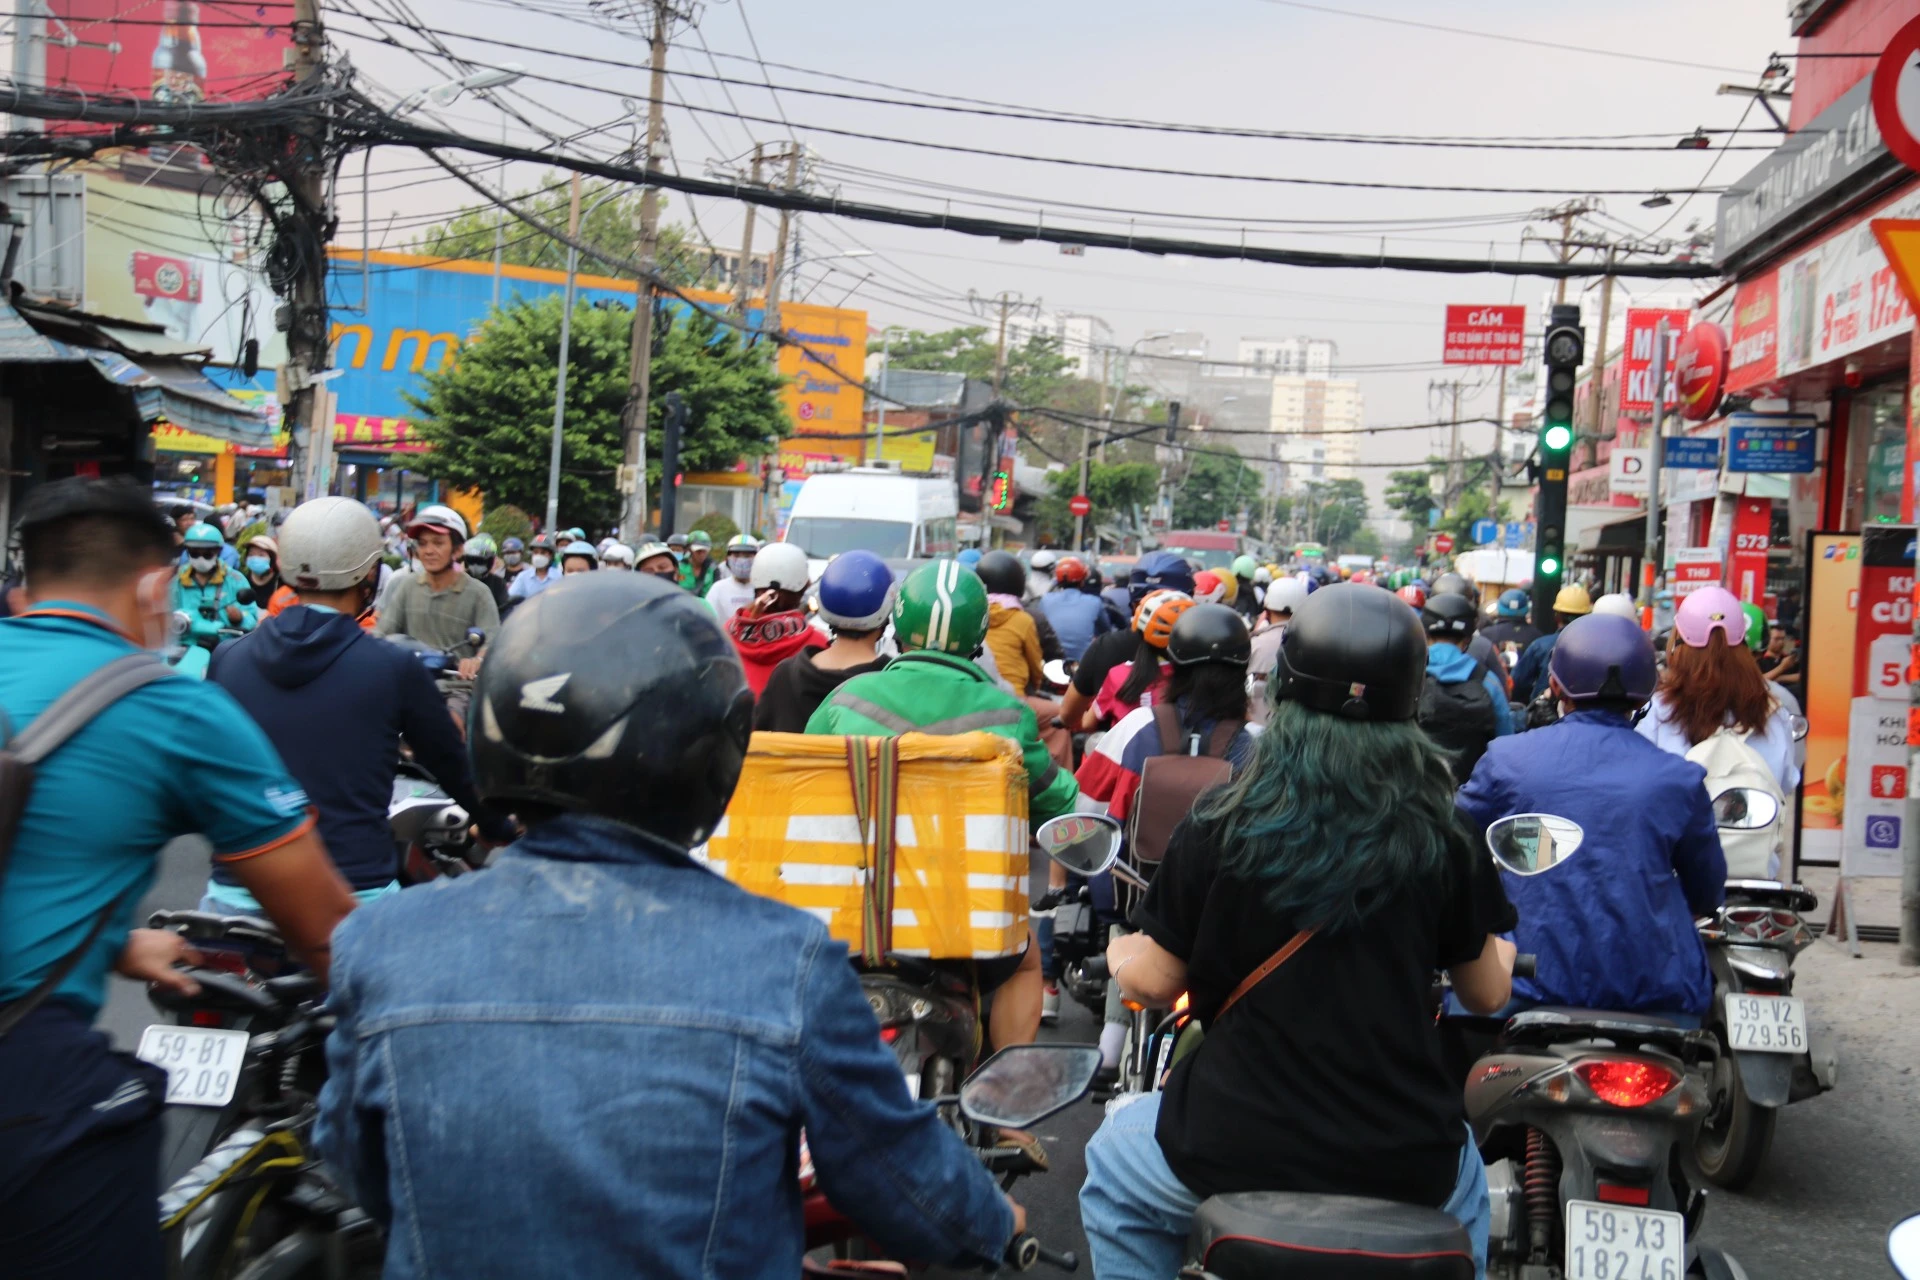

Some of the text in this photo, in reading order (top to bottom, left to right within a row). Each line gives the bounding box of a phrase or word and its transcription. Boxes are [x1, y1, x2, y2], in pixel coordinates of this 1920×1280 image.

[1467, 307, 1503, 326] CẤM
[1736, 533, 1769, 549] 573
[1823, 542, 1858, 562] FPT
[1686, 567, 1710, 579] THU
[1739, 999, 1793, 1023] 59-V2
[1733, 1022, 1801, 1047] 729.56
[155, 1032, 228, 1067] 59-B1
[1585, 1209, 1665, 1250] 59-X3
